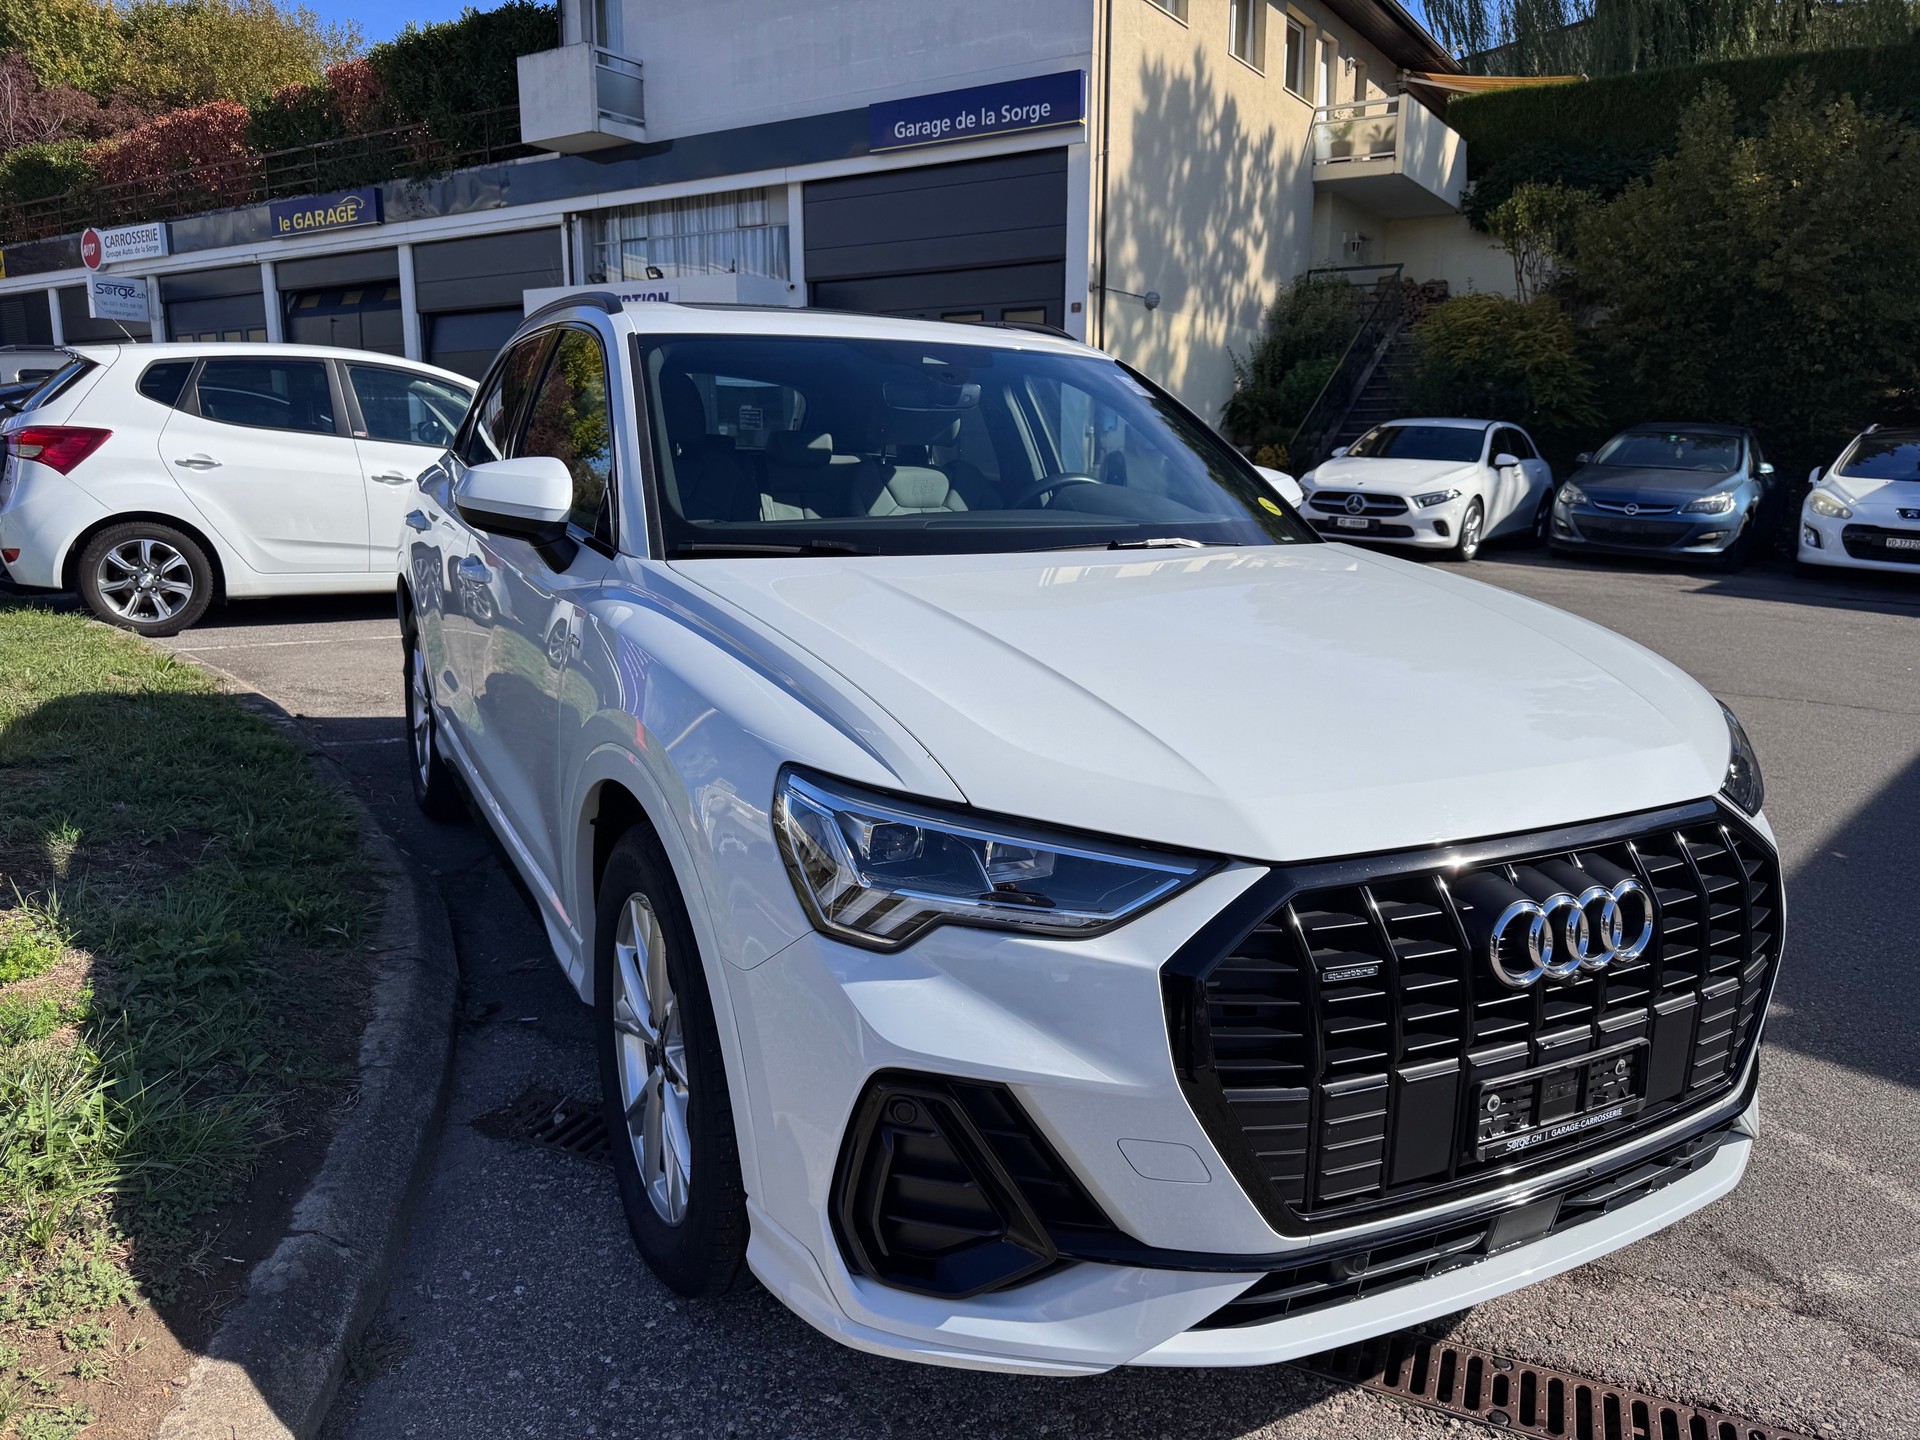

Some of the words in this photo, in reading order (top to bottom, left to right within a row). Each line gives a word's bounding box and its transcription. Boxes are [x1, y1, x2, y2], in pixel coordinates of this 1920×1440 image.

[894, 118, 951, 138] Garage
[955, 111, 976, 129] de
[981, 108, 996, 126] la
[1001, 103, 1051, 123] Sorge
[278, 216, 291, 232] le
[293, 204, 358, 229] GARAGE
[104, 228, 158, 249] CARROSSERIE
[105, 250, 122, 258] Groupe
[134, 246, 140, 254] de
[146, 244, 159, 254] Sorge
[95, 282, 146, 300] Sorge.ch
